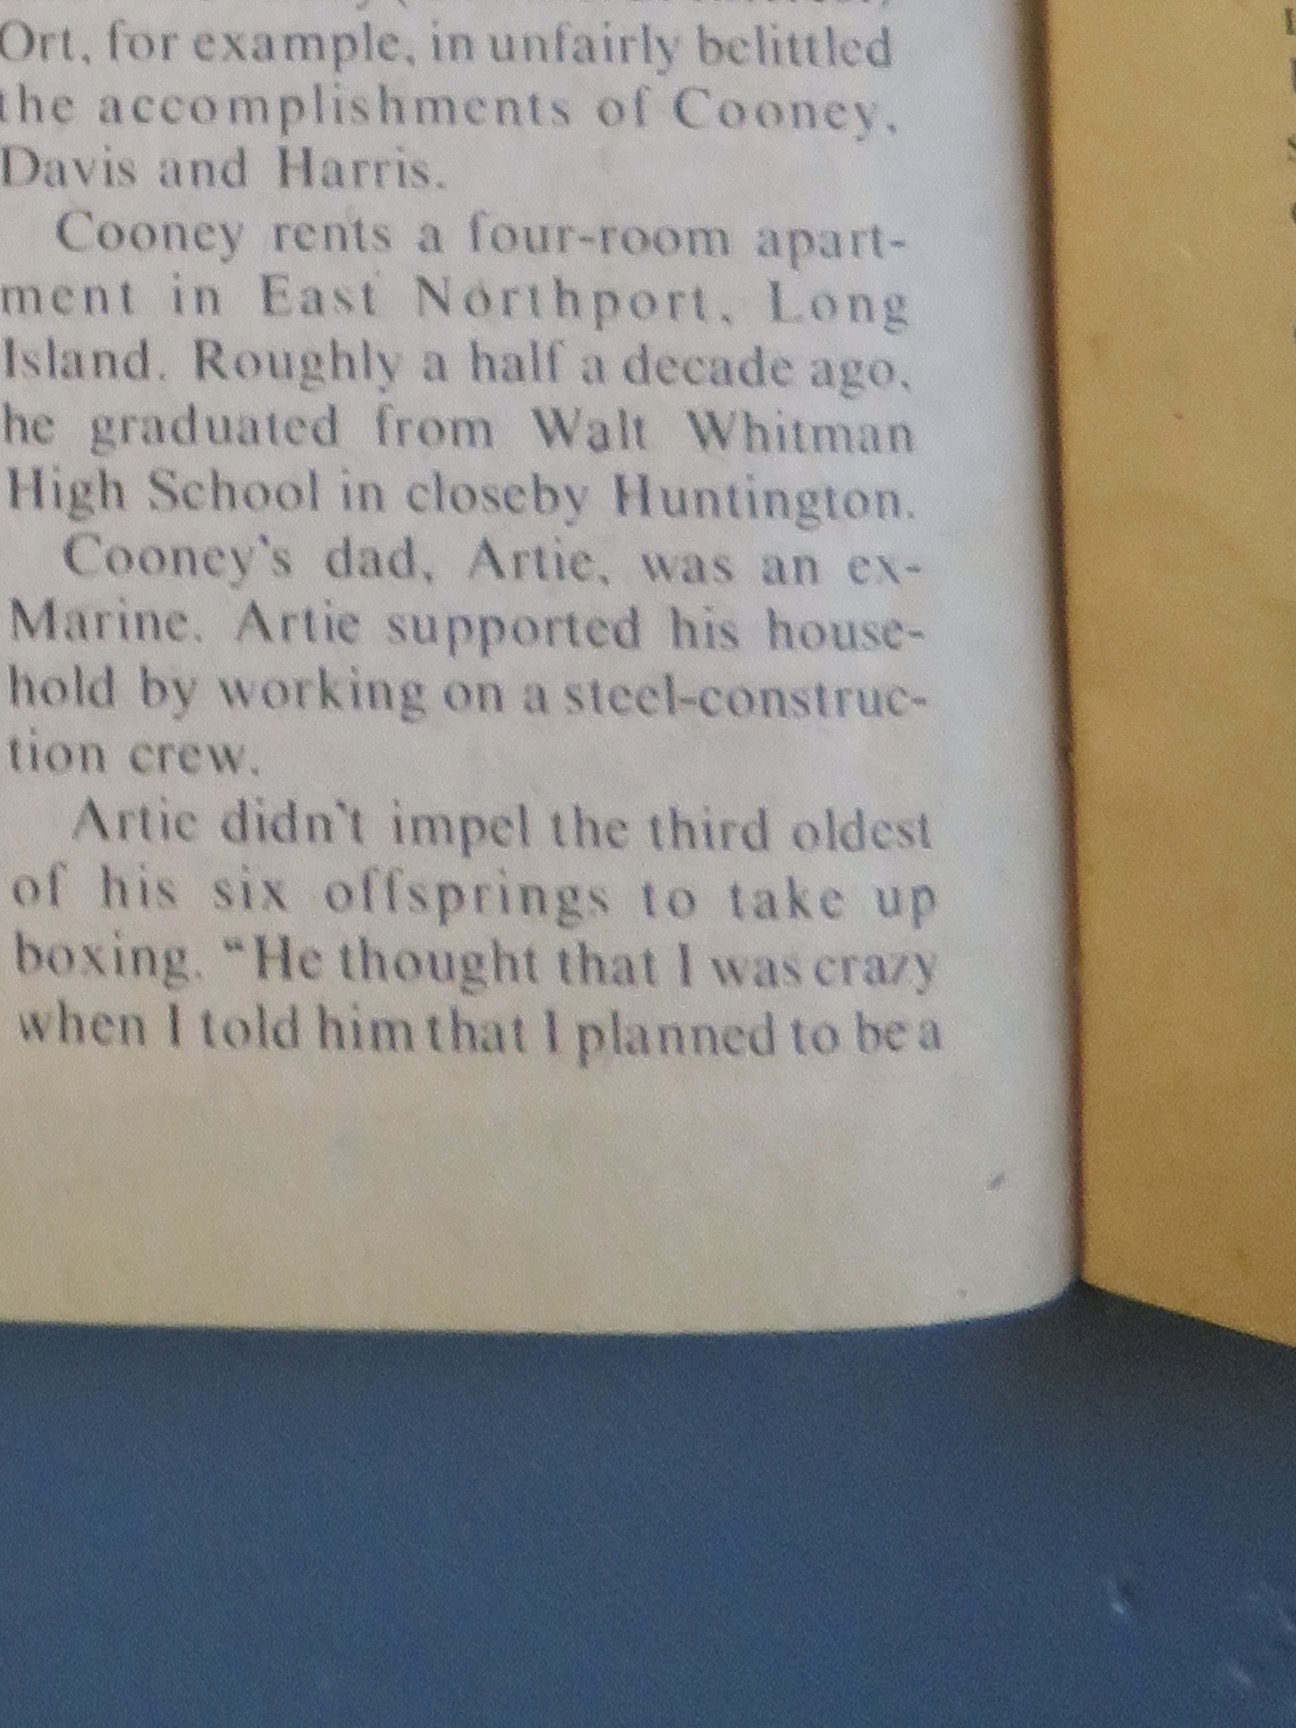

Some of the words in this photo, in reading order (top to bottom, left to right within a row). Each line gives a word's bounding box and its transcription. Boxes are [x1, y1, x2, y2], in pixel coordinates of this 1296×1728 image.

[105, 15, 181, 64] for
[190, 18, 418, 76] example,
[429, 17, 477, 65] in
[487, 18, 682, 79] unfairly
[694, 21, 895, 71] belittled
[170, 270, 223, 318] in
[258, 270, 379, 319] East
[412, 272, 735, 334] Northport,
[766, 277, 911, 338] Long
[5, 463, 128, 525] High
[146, 465, 321, 514] School
[339, 466, 387, 515] in
[404, 468, 591, 529] closeby
[611, 470, 918, 534] Huntington.
[6, 660, 118, 711] hold
[137, 661, 200, 723] by
[216, 663, 430, 727] working
[440, 679, 507, 715] on
[521, 681, 552, 718] a
[562, 670, 930, 720] steel-construc-
[9, 858, 70, 911] of
[98, 861, 179, 912] his
[211, 862, 290, 914] six
[322, 864, 612, 932] offsprings
[639, 879, 699, 921] to
[727, 873, 846, 923] take
[873, 882, 939, 932] up
